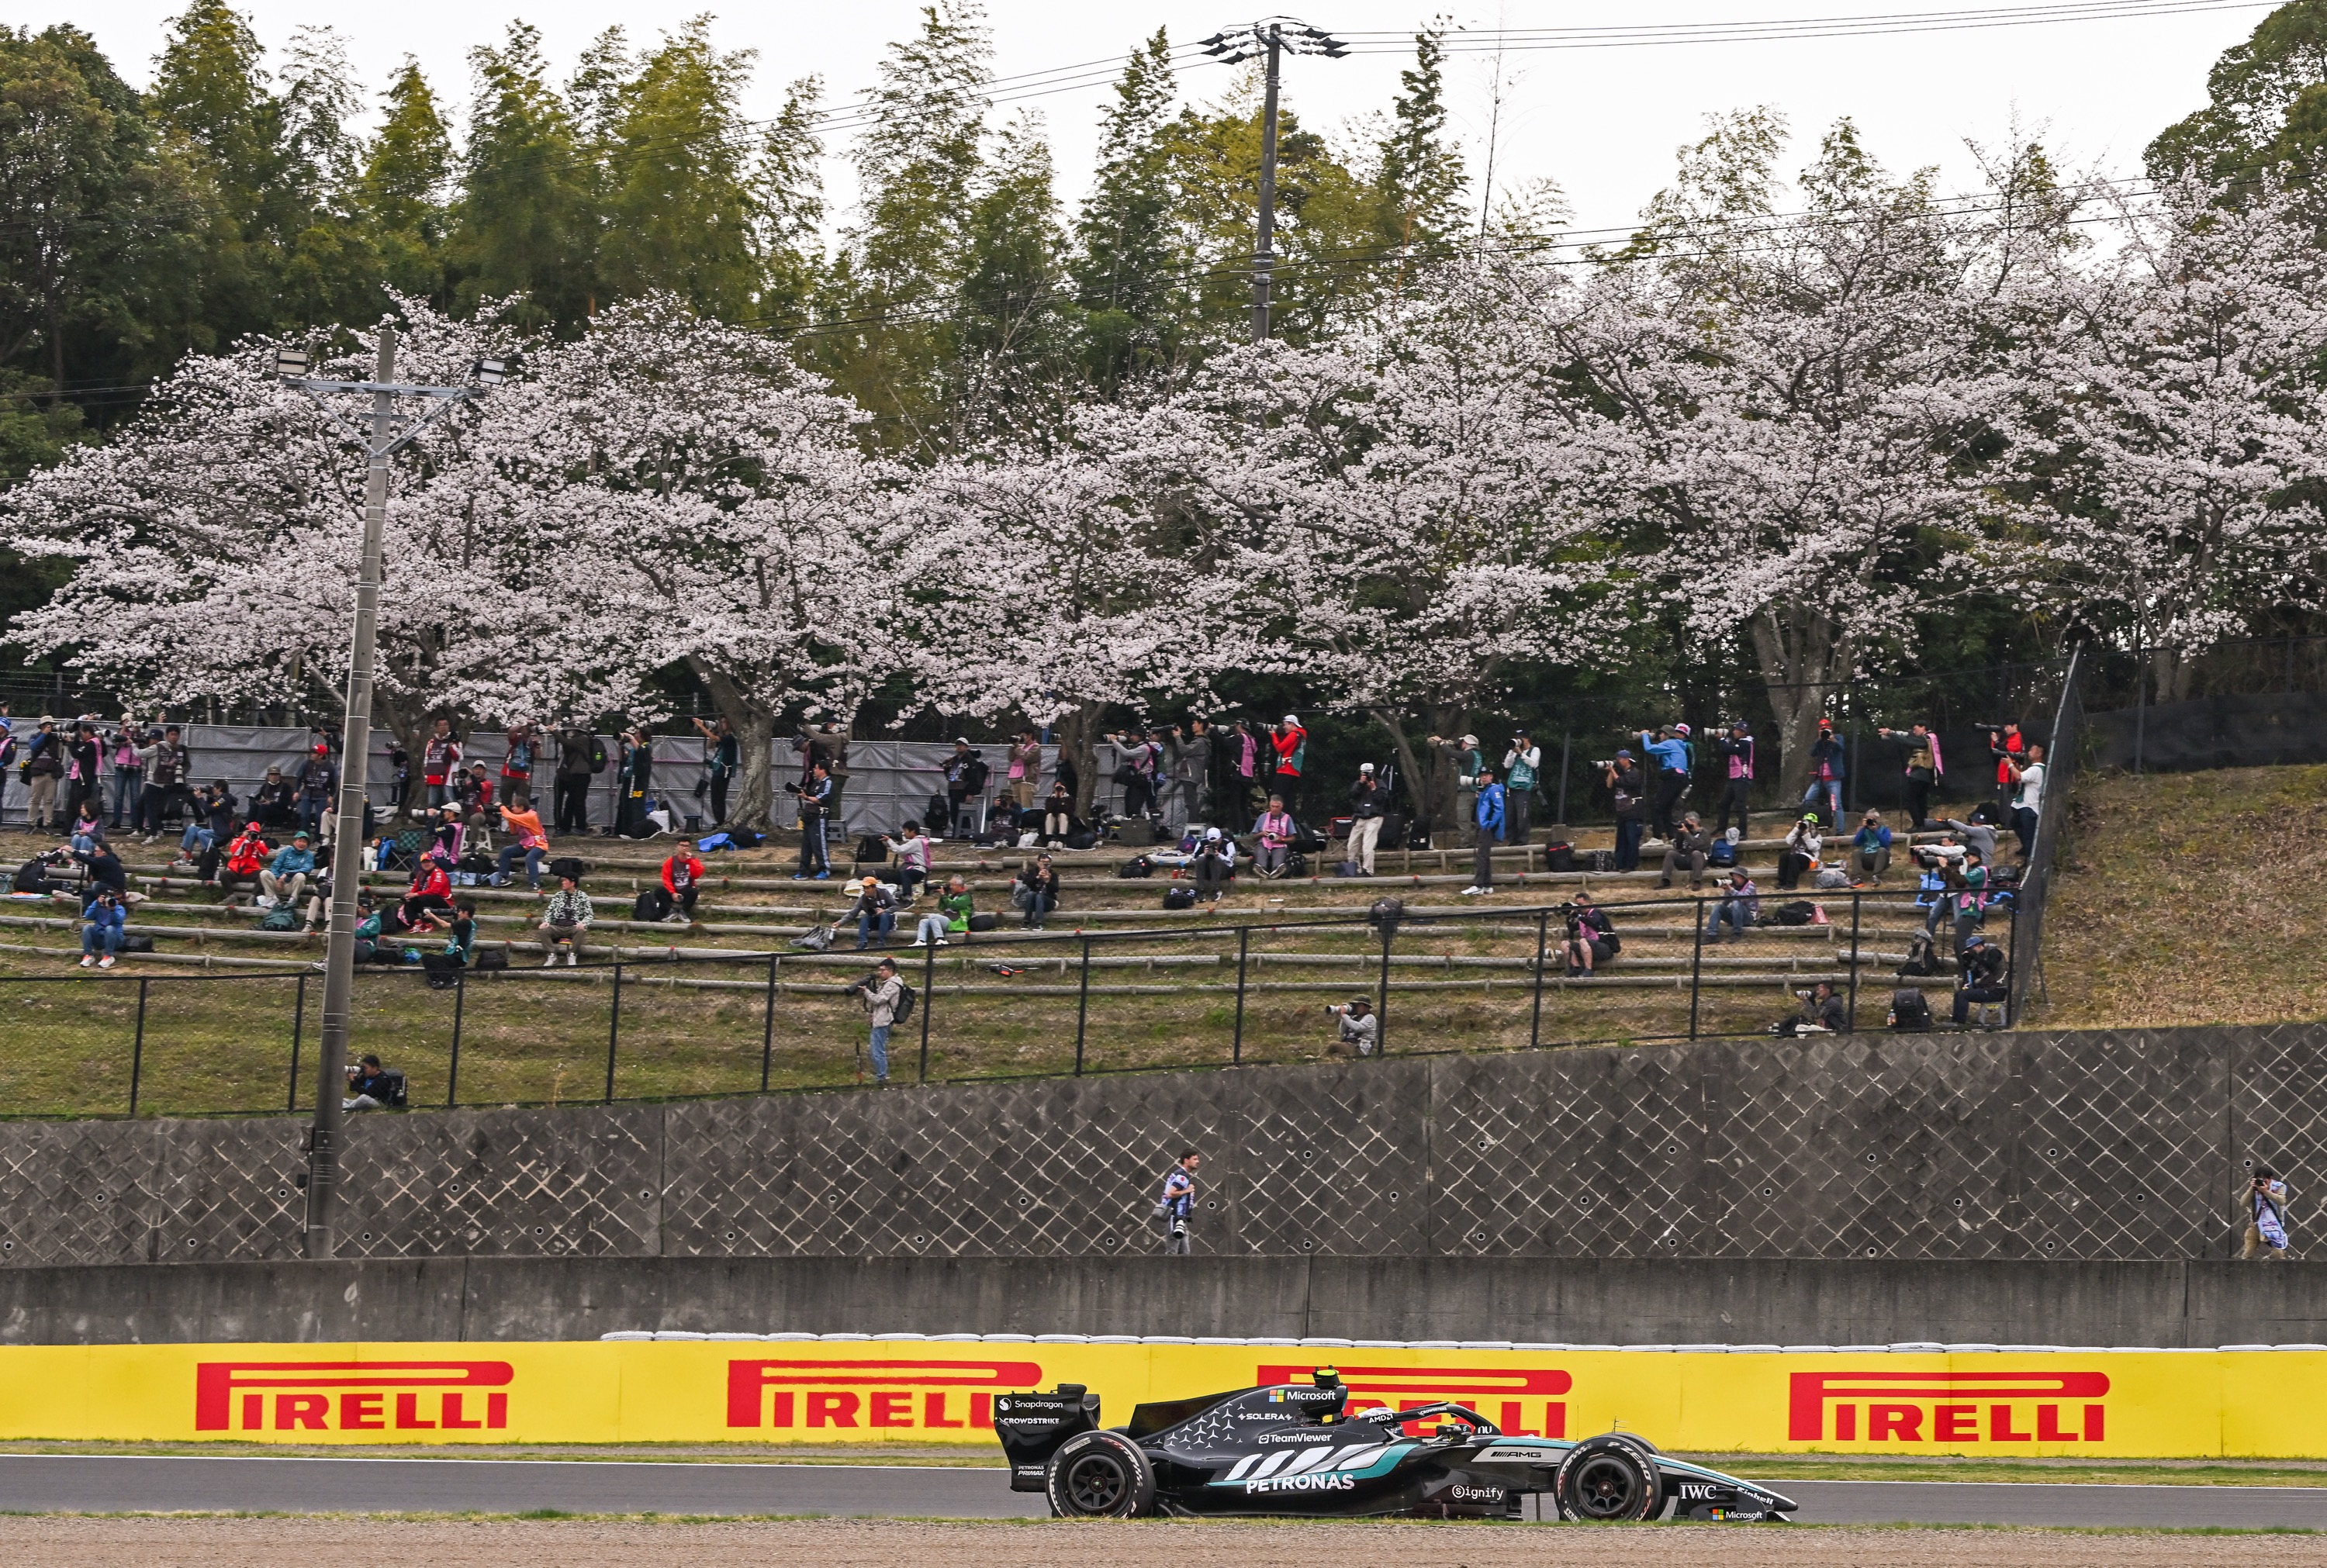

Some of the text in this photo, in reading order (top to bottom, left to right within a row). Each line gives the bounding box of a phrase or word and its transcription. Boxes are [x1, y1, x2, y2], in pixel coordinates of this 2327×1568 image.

[196, 1361, 513, 1431] PIRELLI
[728, 1360, 1042, 1428] PIRELL
[1287, 1390, 1336, 1400] Microsoft
[1015, 1400, 1063, 1410] Snapdragon
[1789, 1372, 2110, 1442] PIRELLI
[1368, 1414, 1387, 1424] AMD
[1270, 1433, 1333, 1443] TeamViewer
[1620, 1445, 1653, 1482] ZERO
[1246, 1473, 1356, 1494] PETRONAS
[1680, 1484, 1717, 1500] IWC
[1725, 1511, 1763, 1519] Microsoft
